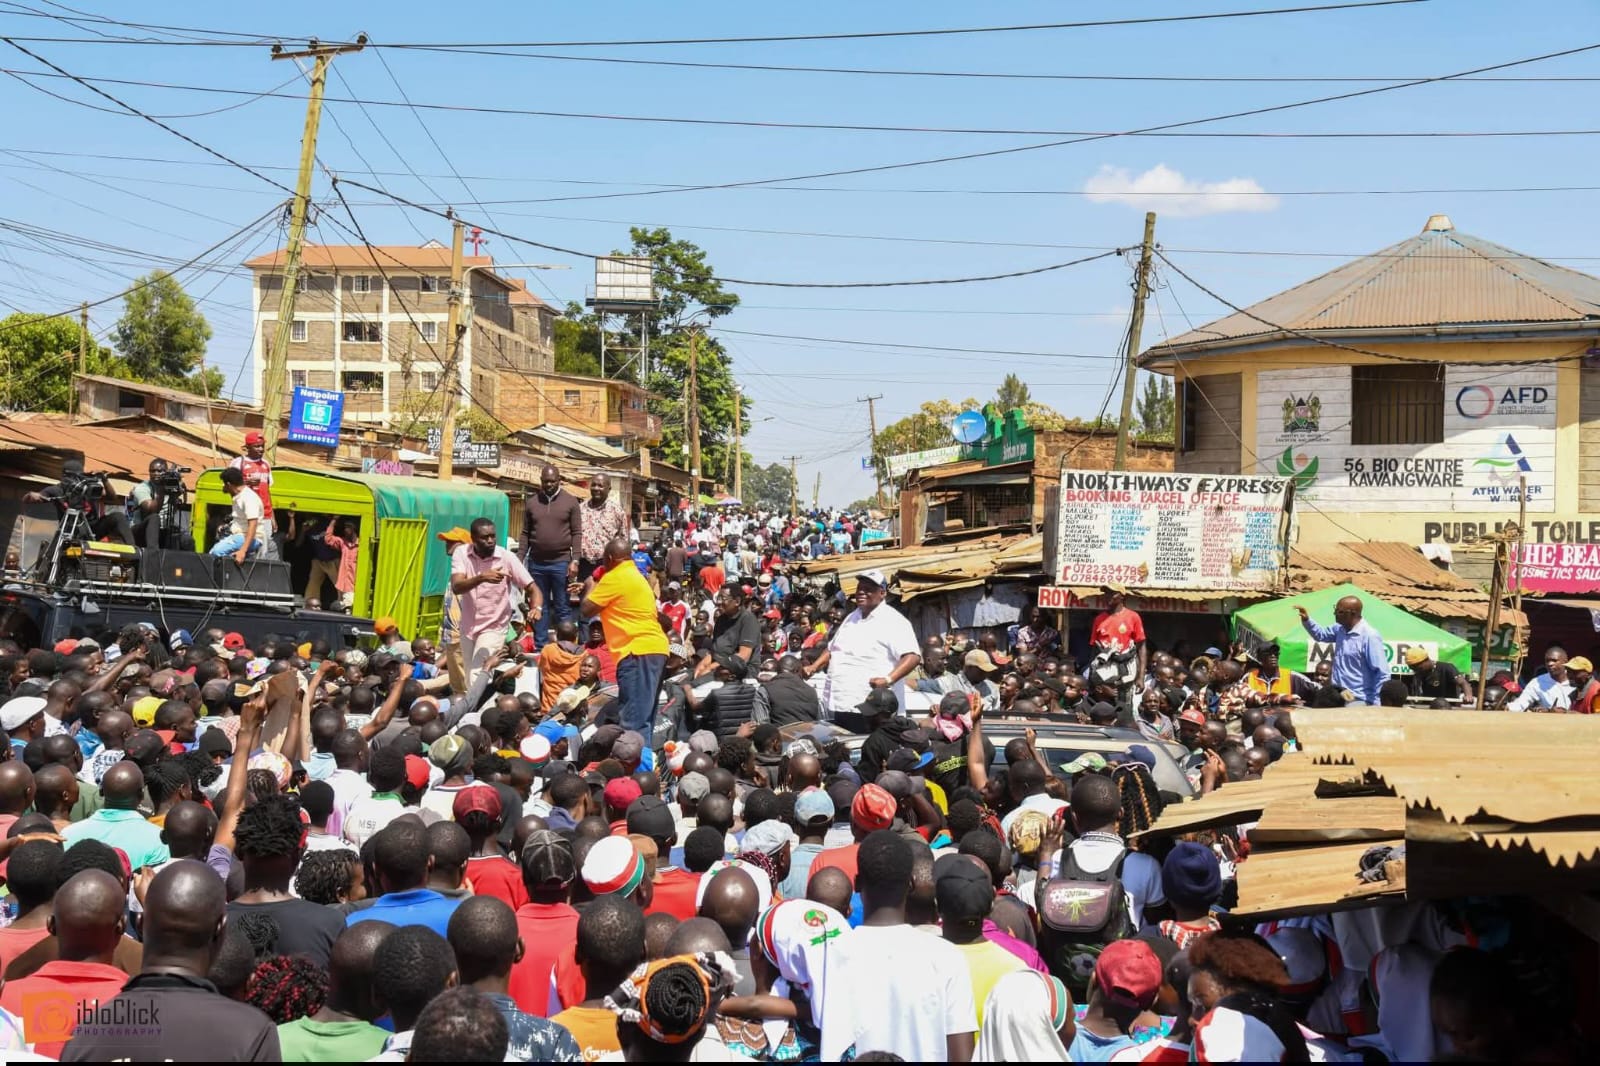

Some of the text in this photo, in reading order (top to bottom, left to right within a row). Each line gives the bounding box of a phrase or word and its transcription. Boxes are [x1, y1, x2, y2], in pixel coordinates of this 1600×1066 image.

[300, 389, 339, 401] Netpoint
[1500, 387, 1548, 404] AFD
[460, 451, 490, 459] CHURCH
[1343, 458, 1463, 472] 56 BIO CENTRE
[505, 468, 532, 480] HOTEL
[1349, 472, 1464, 487] KAWANGWARE
[1067, 473, 1286, 495] NORTHWAYS EXPRESS
[1472, 485, 1542, 495] ATHI WAER
[1066, 490, 1240, 504] BOOKING PARCEL OFFICE
[1424, 521, 1508, 544] PUBLI
[1071, 574, 1145, 584] 0784629754
